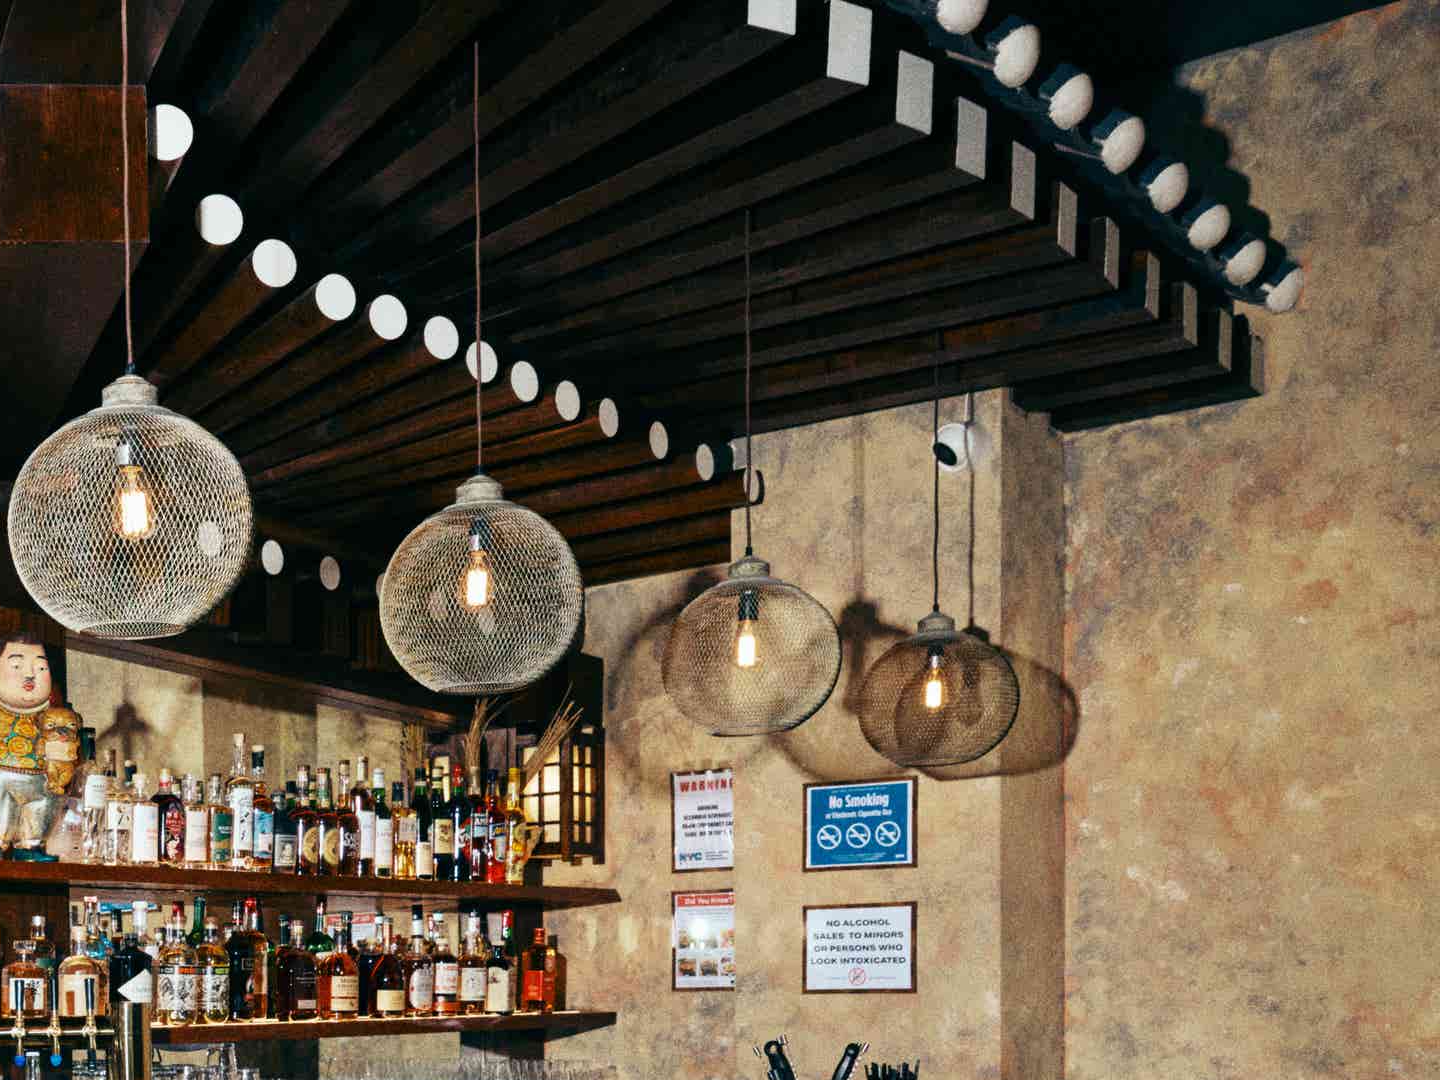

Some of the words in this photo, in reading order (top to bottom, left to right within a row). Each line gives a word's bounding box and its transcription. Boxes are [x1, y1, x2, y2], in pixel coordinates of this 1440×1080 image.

[828, 795, 843, 809] No
[845, 792, 890, 808] Smoking
[679, 851, 702, 861] NYC
[826, 919, 841, 927] NO
[842, 918, 892, 927] ALCOHOL
[813, 932, 845, 940] SALES
[848, 931, 862, 939] TO
[863, 930, 904, 939] MINORS
[830, 944, 877, 952] PERSONS
[878, 943, 903, 951] WHO
[810, 957, 838, 965] LOOK
[840, 956, 907, 965] INTOXICATED
